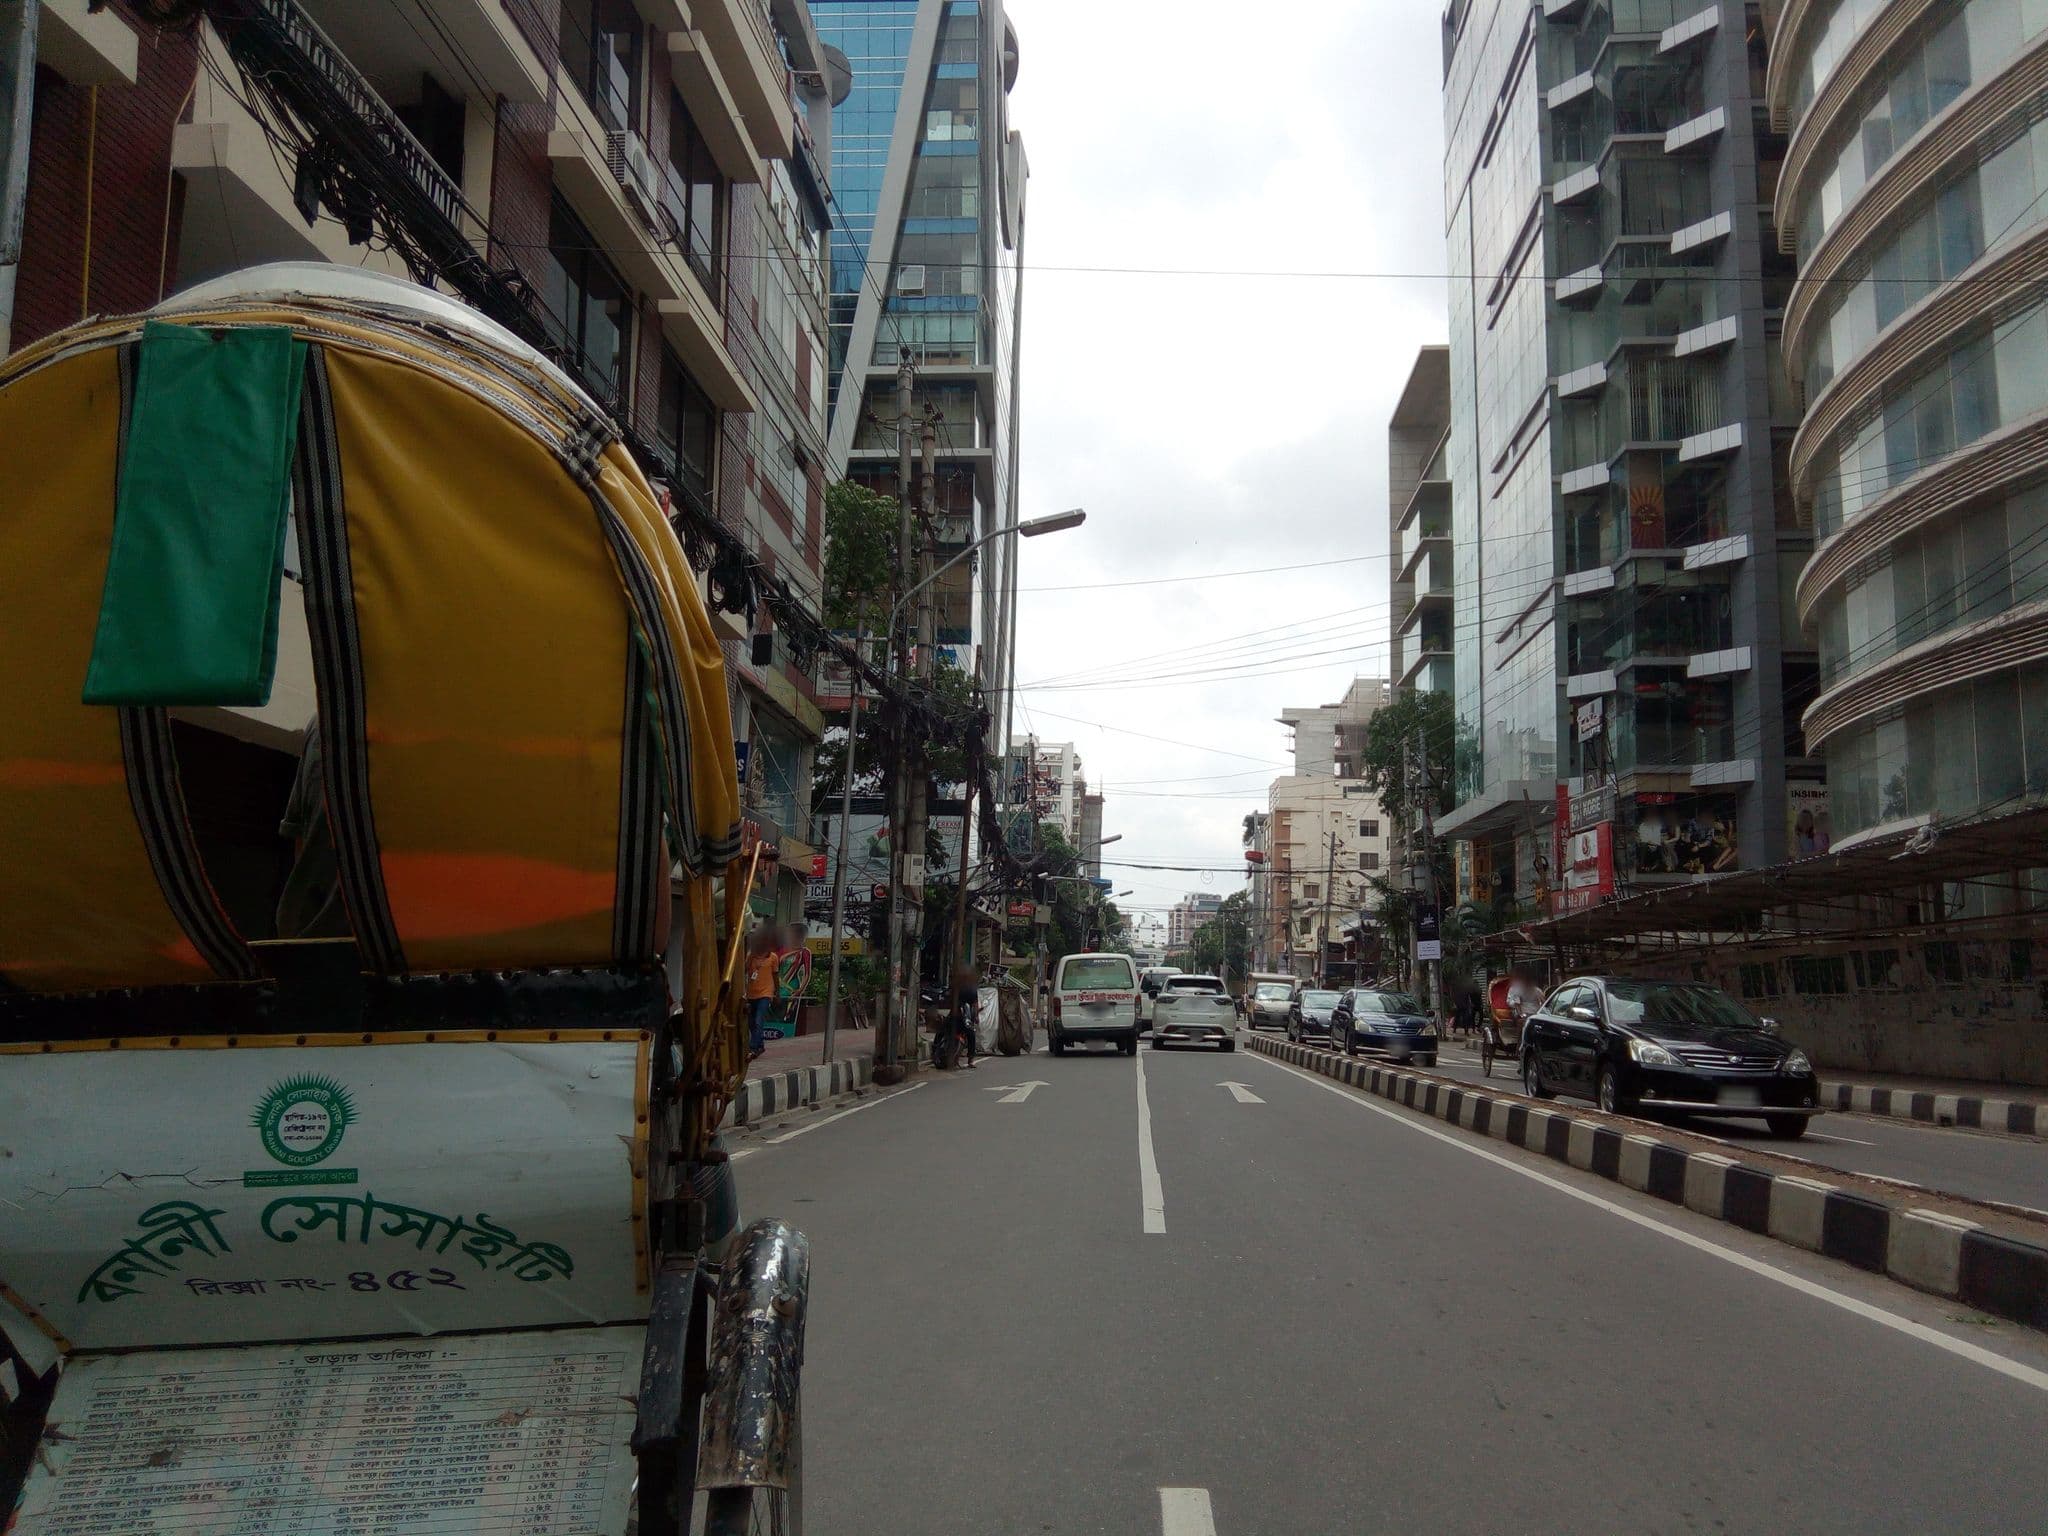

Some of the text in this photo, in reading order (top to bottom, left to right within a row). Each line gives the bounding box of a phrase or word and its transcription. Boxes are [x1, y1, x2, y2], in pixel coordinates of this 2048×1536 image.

[266, 1131, 286, 1160] BANANI
[287, 1152, 324, 1166] SOCIETY
[77, 1191, 575, 1303] বনানী সোসাইটি
[348, 1267, 467, 1293] ৪৫২
[367, 1349, 436, 1362] তালিকা
